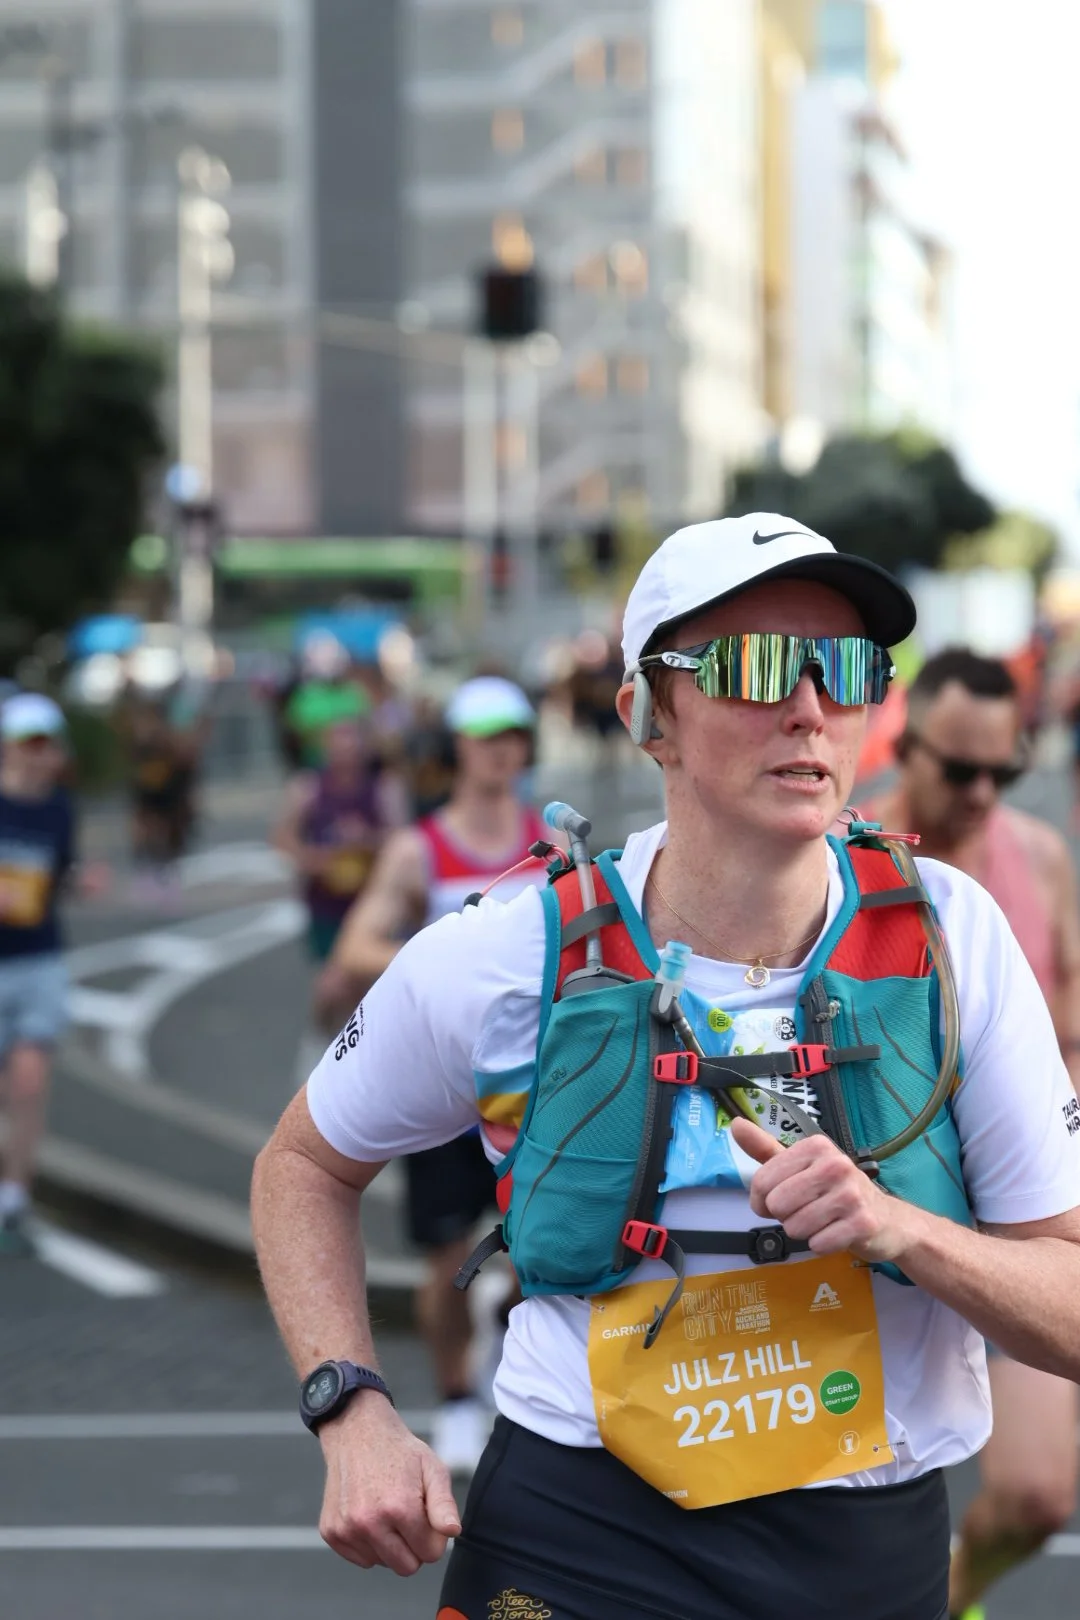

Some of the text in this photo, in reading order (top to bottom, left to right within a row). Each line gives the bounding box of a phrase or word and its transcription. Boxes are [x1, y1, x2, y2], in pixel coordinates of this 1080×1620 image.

[346, 1012, 360, 1049] NG
[334, 1033, 348, 1062] TS
[688, 1093, 702, 1127] SALTED
[769, 1104, 778, 1126] CRISPS
[780, 1073, 805, 1134] NAS
[1062, 1097, 1080, 1121] TAUR
[1066, 1115, 1080, 1137] MAR
[681, 1280, 768, 1317] RUN THE
[683, 1308, 733, 1341] CITY
[735, 1319, 770, 1331] MARATHON
[663, 1340, 812, 1395] JULZ HILL
[825, 1394, 858, 1407] START GROUP
[826, 1383, 853, 1395] GREEN
[673, 1383, 816, 1448] 22179
